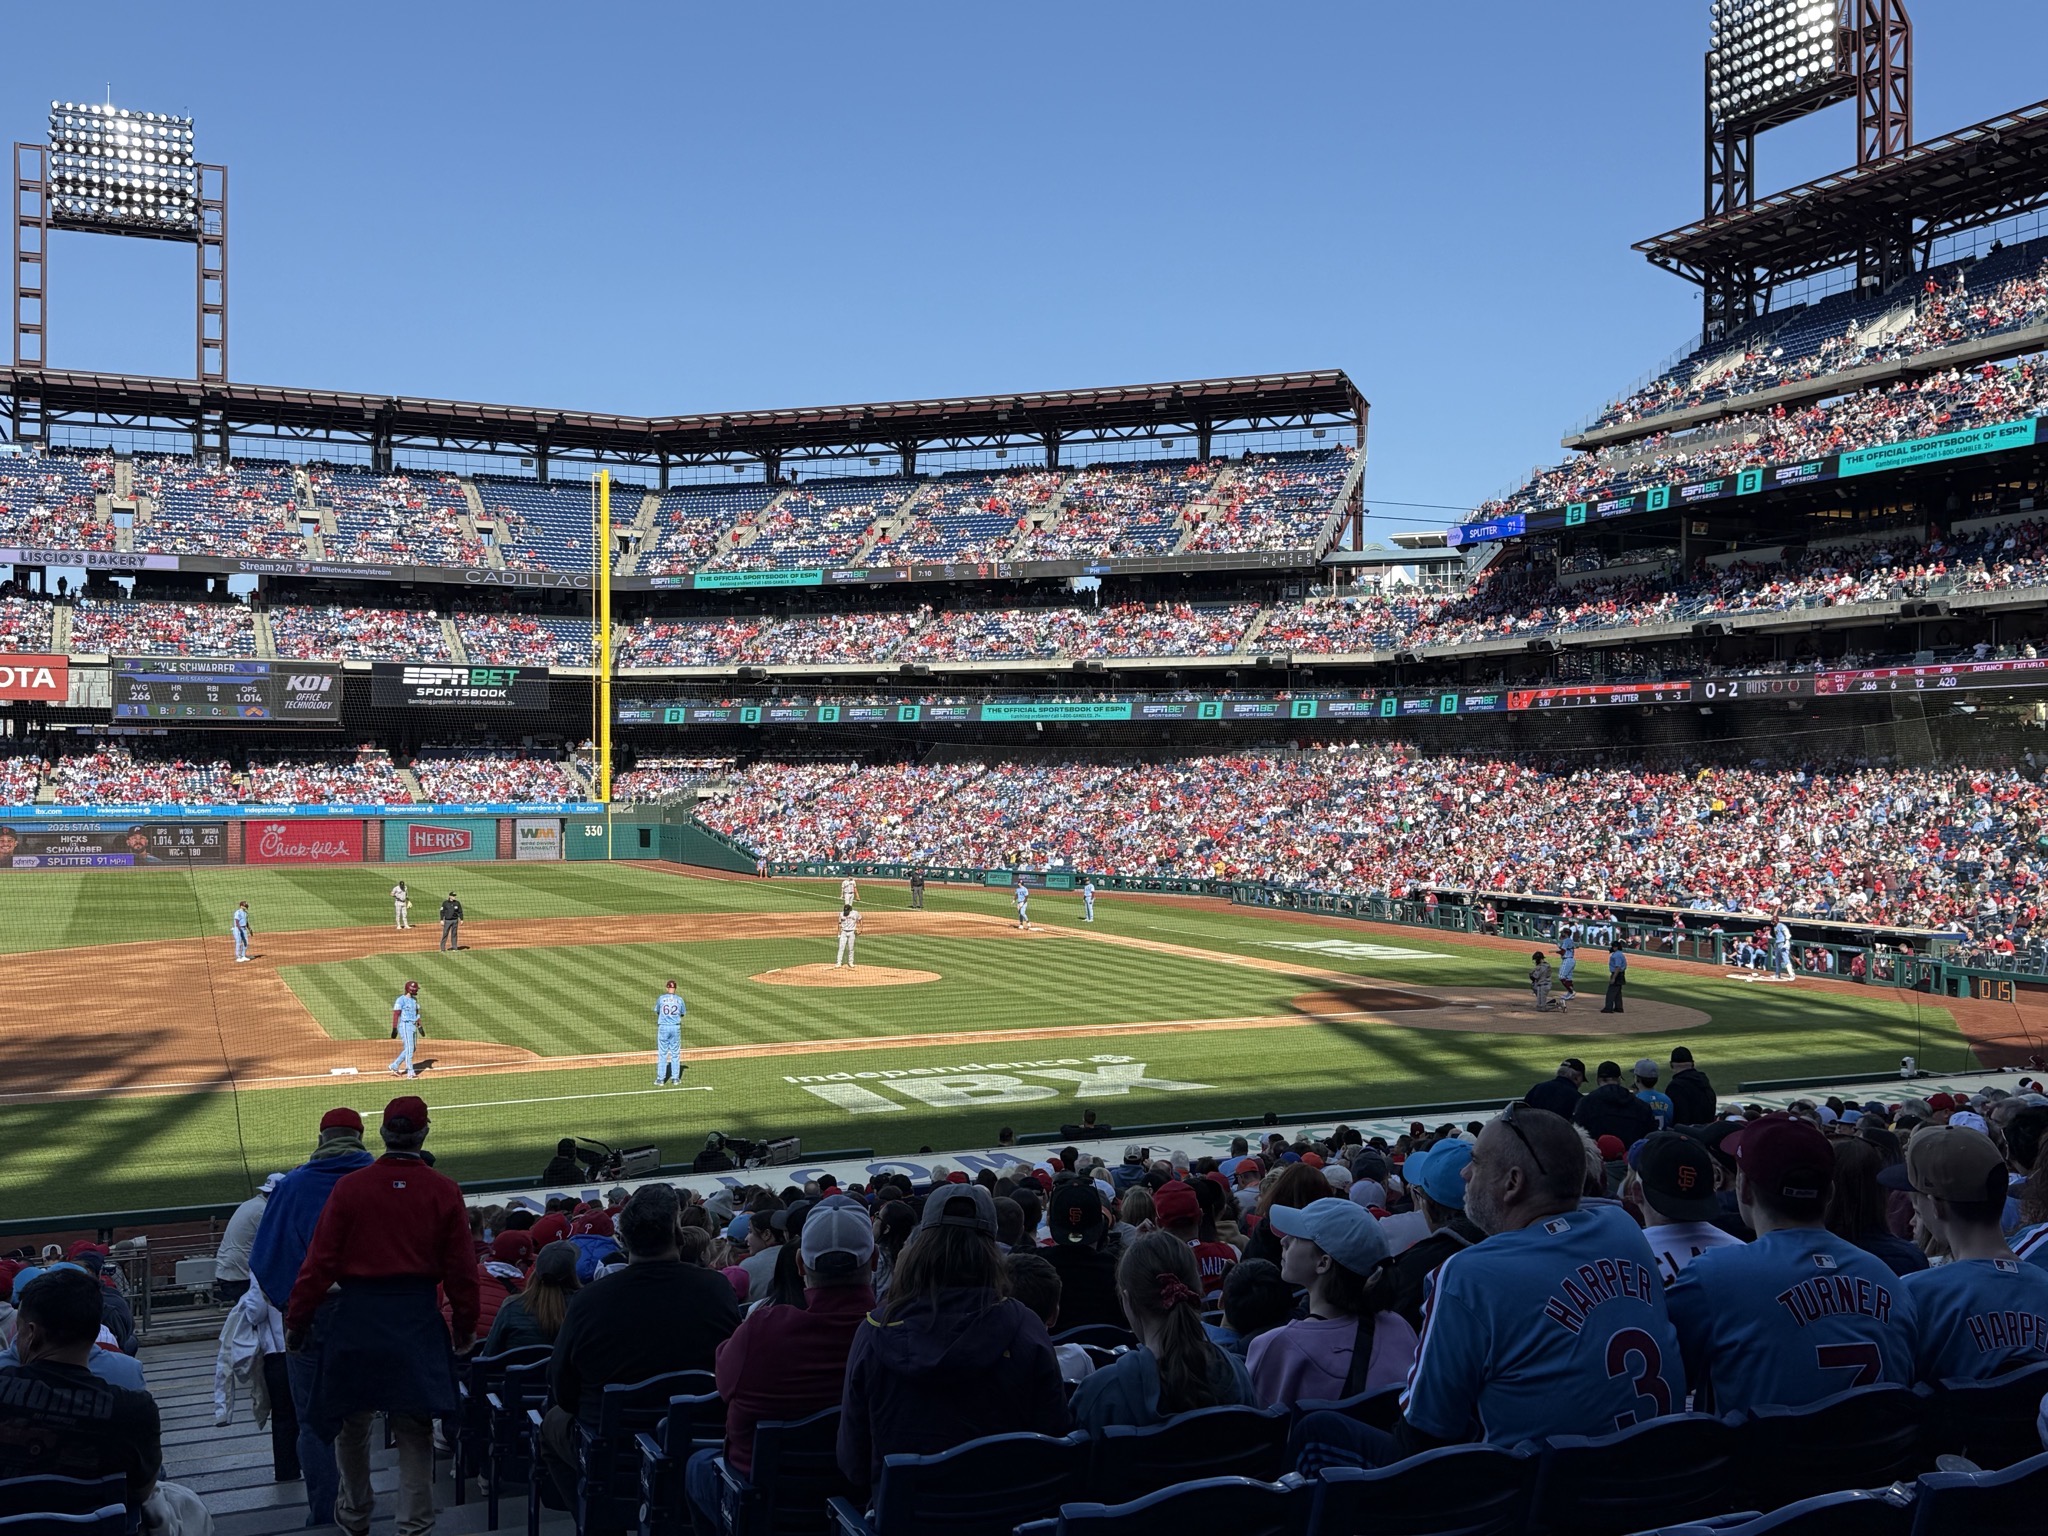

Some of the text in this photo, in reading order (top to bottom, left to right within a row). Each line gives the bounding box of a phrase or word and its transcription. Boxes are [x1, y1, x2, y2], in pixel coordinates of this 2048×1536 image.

[1846, 425, 2027, 465] THE OFFICIAL SPORTSBOOK OF ESPN
[1875, 458, 1900, 468] Gambling
[1901, 453, 1926, 465] problem?
[1776, 461, 1824, 480] ESPN BET
[1781, 474, 1819, 485] SPORTSBOOK
[1681, 480, 1725, 497] ESPN BET
[1686, 492, 1720, 502] SPORTSBOOK
[1597, 496, 1636, 512] ESPN BET
[1469, 520, 1516, 538] SPLITTER 91
[20, 552, 147, 567] LISCIO'S BAKERY
[1262, 556, 1268, 564] R
[1280, 555, 1286, 563] H
[239, 561, 293, 574] Stream 24/7
[312, 565, 392, 576] MLBNetwork.com/stream
[465, 570, 588, 588] CADILLAC
[832, 570, 870, 579] ESPN BET
[999, 570, 1012, 578] CIN
[154, 662, 177, 672] KYLE
[1972, 663, 2003, 672] DISTANCE
[402, 667, 520, 687] ESPN BET
[286, 675, 333, 691] KDI
[1746, 681, 1767, 693] OUTS
[1836, 677, 1957, 692] 12 .266 6 12 .420
[128, 692, 262, 702] .266 6 12 1.014
[296, 692, 322, 702] OFFICE
[416, 687, 507, 697] SPORTSBOOK
[407, 698, 433, 706] Gambling
[1419, 699, 1434, 708] BET
[1482, 695, 1498, 705] BET
[1576, 697, 1581, 705] 7
[1589, 696, 1597, 704] 14
[1610, 693, 1639, 703] SPLITTER
[1655, 692, 1663, 700] 16
[1672, 691, 1681, 700] -3
[284, 701, 333, 709] TECHNOLOGY
[1168, 705, 1187, 713] BET
[1259, 703, 1280, 712] BET
[1355, 702, 1374, 710] BET
[953, 707, 971, 715] BET
[47, 823, 101, 831] 2025 STATS
[584, 825, 603, 836] 330
[520, 828, 555, 838] WM
[60, 835, 88, 843] HICKS
[153, 835, 218, 845] 1.014 .434 .451
[414, 831, 464, 848] HERR'S
[46, 846, 102, 854] SCHWARBER
[260, 831, 350, 859] Chick-fil-A
[189, 848, 201, 856] 180
[47, 857, 92, 866] SPLITTER
[97, 857, 107, 865] 91
[663, 1004, 678, 1016] 62
[782, 1056, 1083, 1085] Independence
[801, 1062, 1219, 1115] IBX
[1543, 1258, 1653, 1335] HARPER
[1776, 1275, 1892, 1328] TURNER
[1966, 1310, 2048, 1354] HARPE
[1815, 1341, 1884, 1388] 7
[1605, 1326, 1673, 1432] 3
